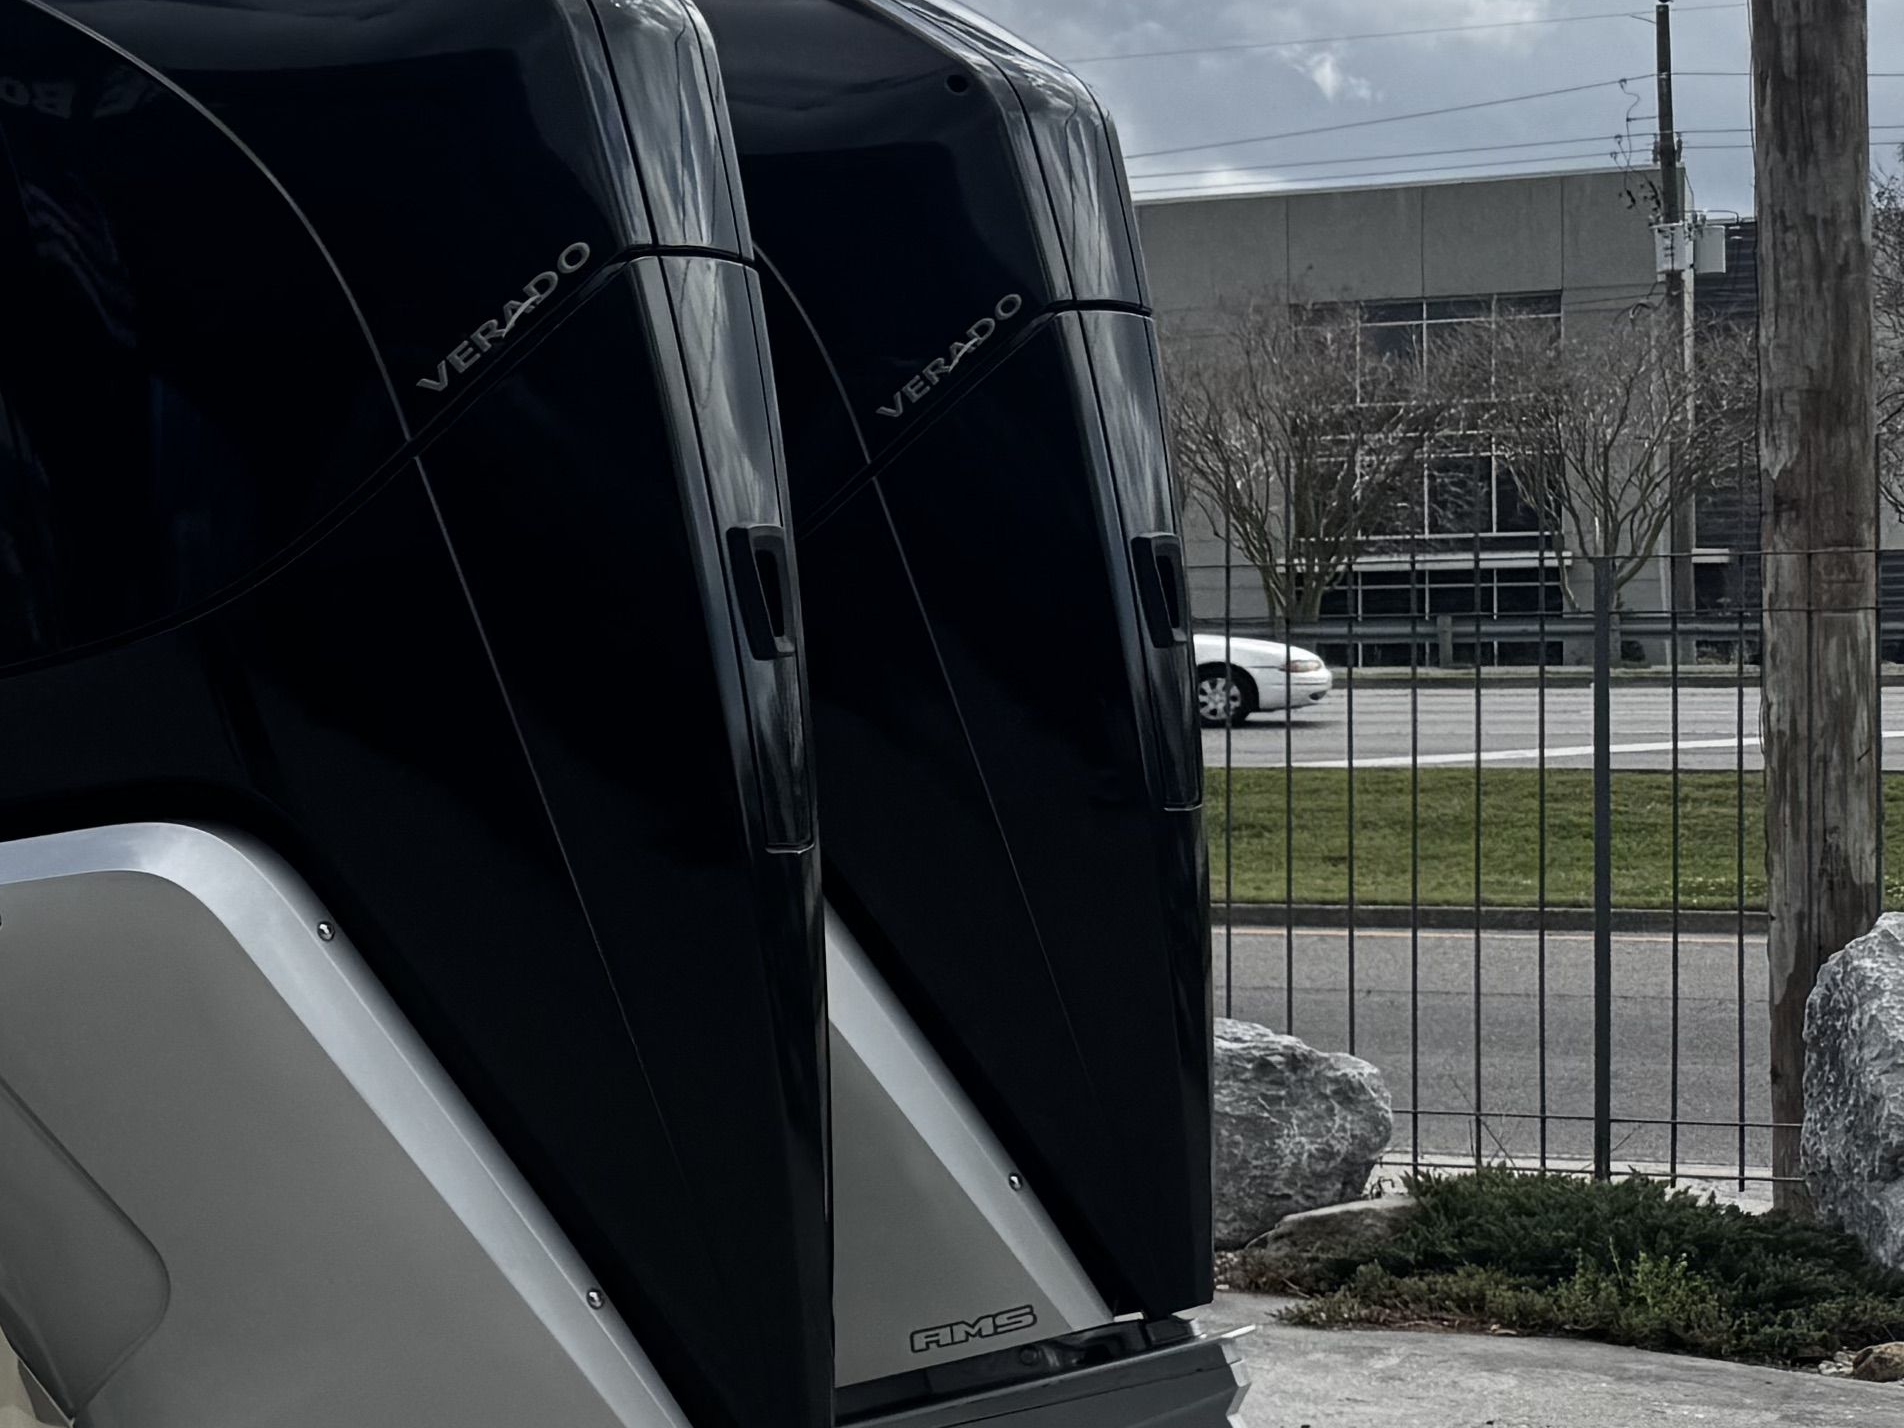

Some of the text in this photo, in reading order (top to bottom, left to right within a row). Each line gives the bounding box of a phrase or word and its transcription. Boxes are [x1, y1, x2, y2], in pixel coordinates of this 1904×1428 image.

[416, 242, 591, 392] VERADO
[875, 293, 1022, 417] VERADO
[909, 1304, 1038, 1353] AMS
